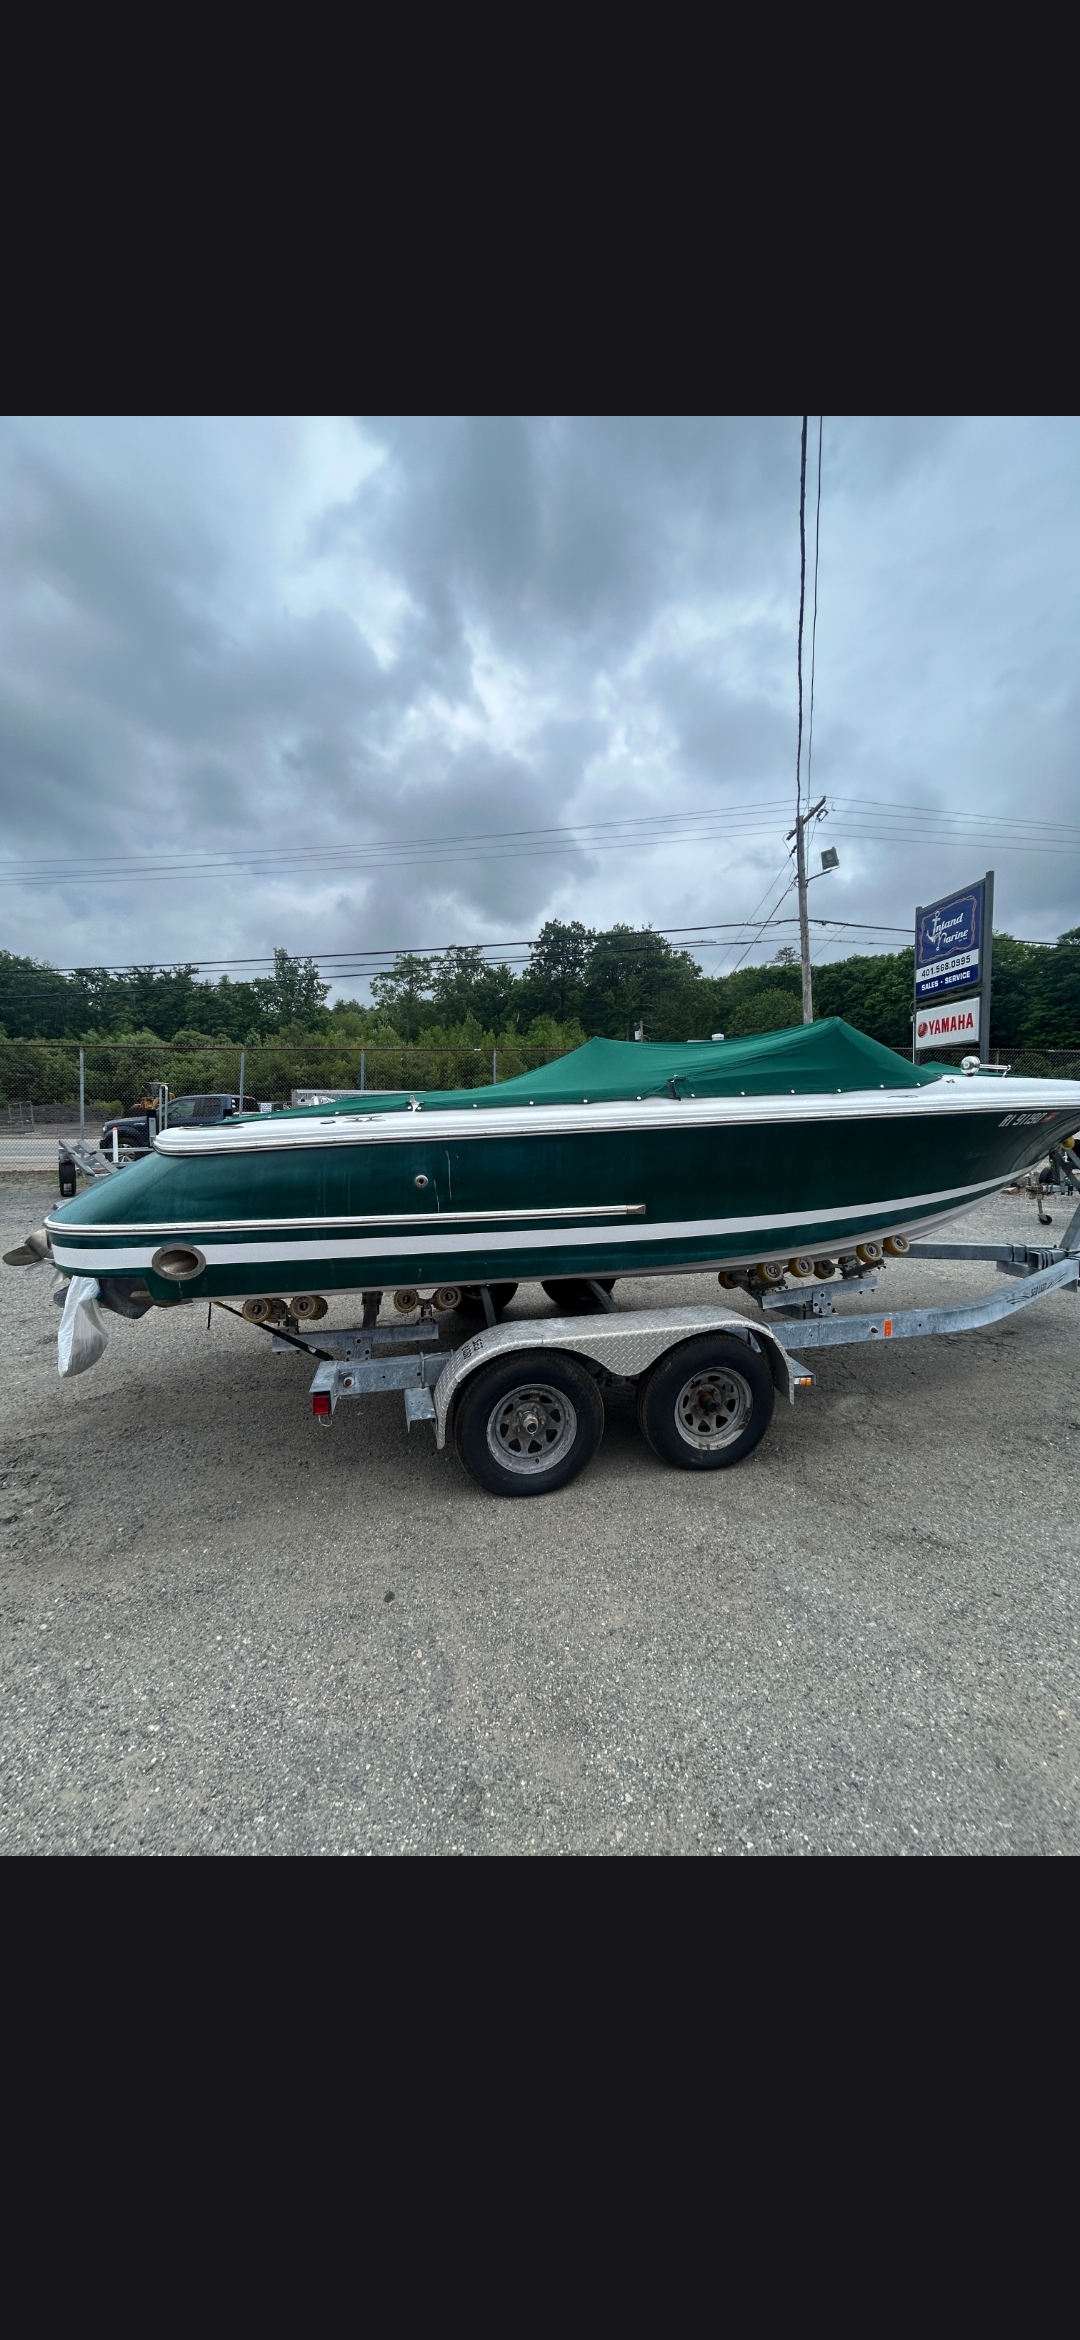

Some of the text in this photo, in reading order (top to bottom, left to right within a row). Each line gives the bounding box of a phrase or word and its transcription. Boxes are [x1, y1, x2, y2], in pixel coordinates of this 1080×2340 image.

[921, 955, 971, 977] 401.568.0995
[921, 970, 971, 991] SALES SERVICE
[928, 1012, 974, 1035] YAMAHA
